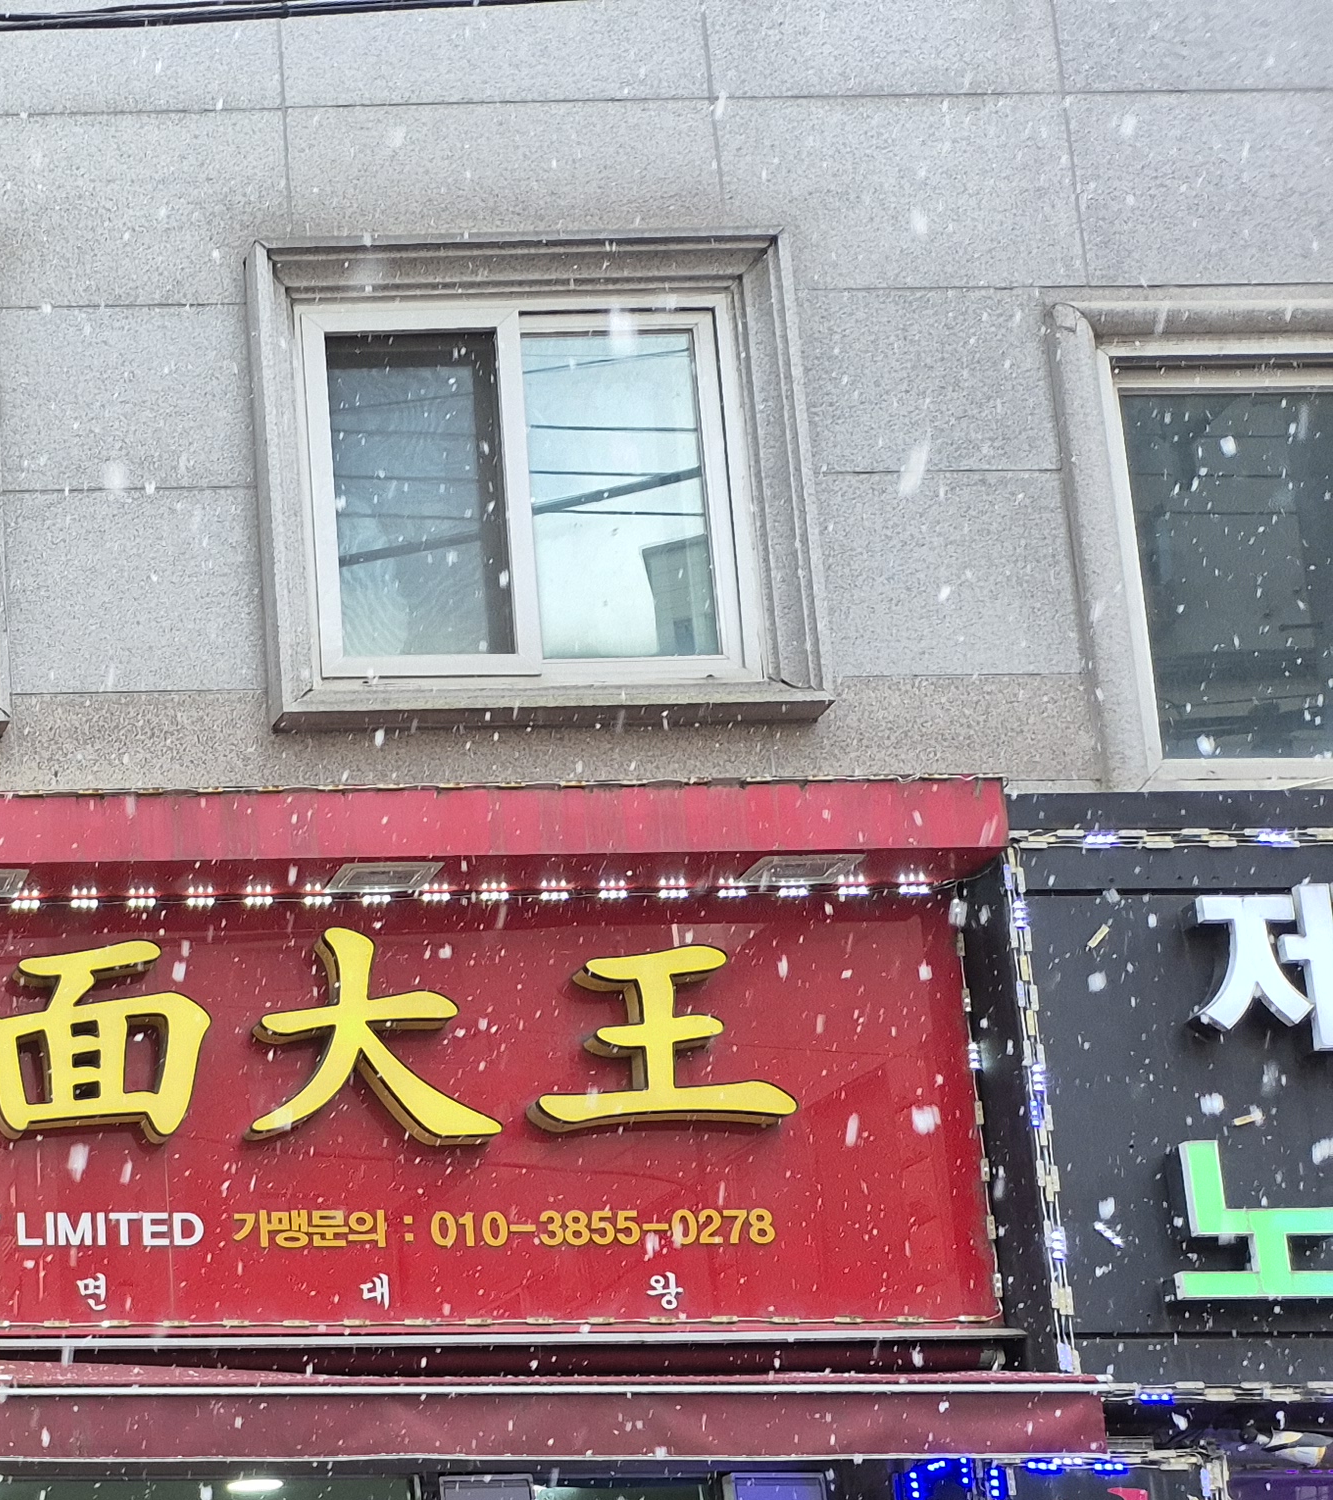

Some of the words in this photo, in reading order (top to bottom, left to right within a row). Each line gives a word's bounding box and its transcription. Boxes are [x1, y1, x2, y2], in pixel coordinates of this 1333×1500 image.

[17, 1212, 205, 1249] LIMITED
[234, 1209, 387, 1249] 가맹문의
[431, 1208, 775, 1248] 010-3855-0278
